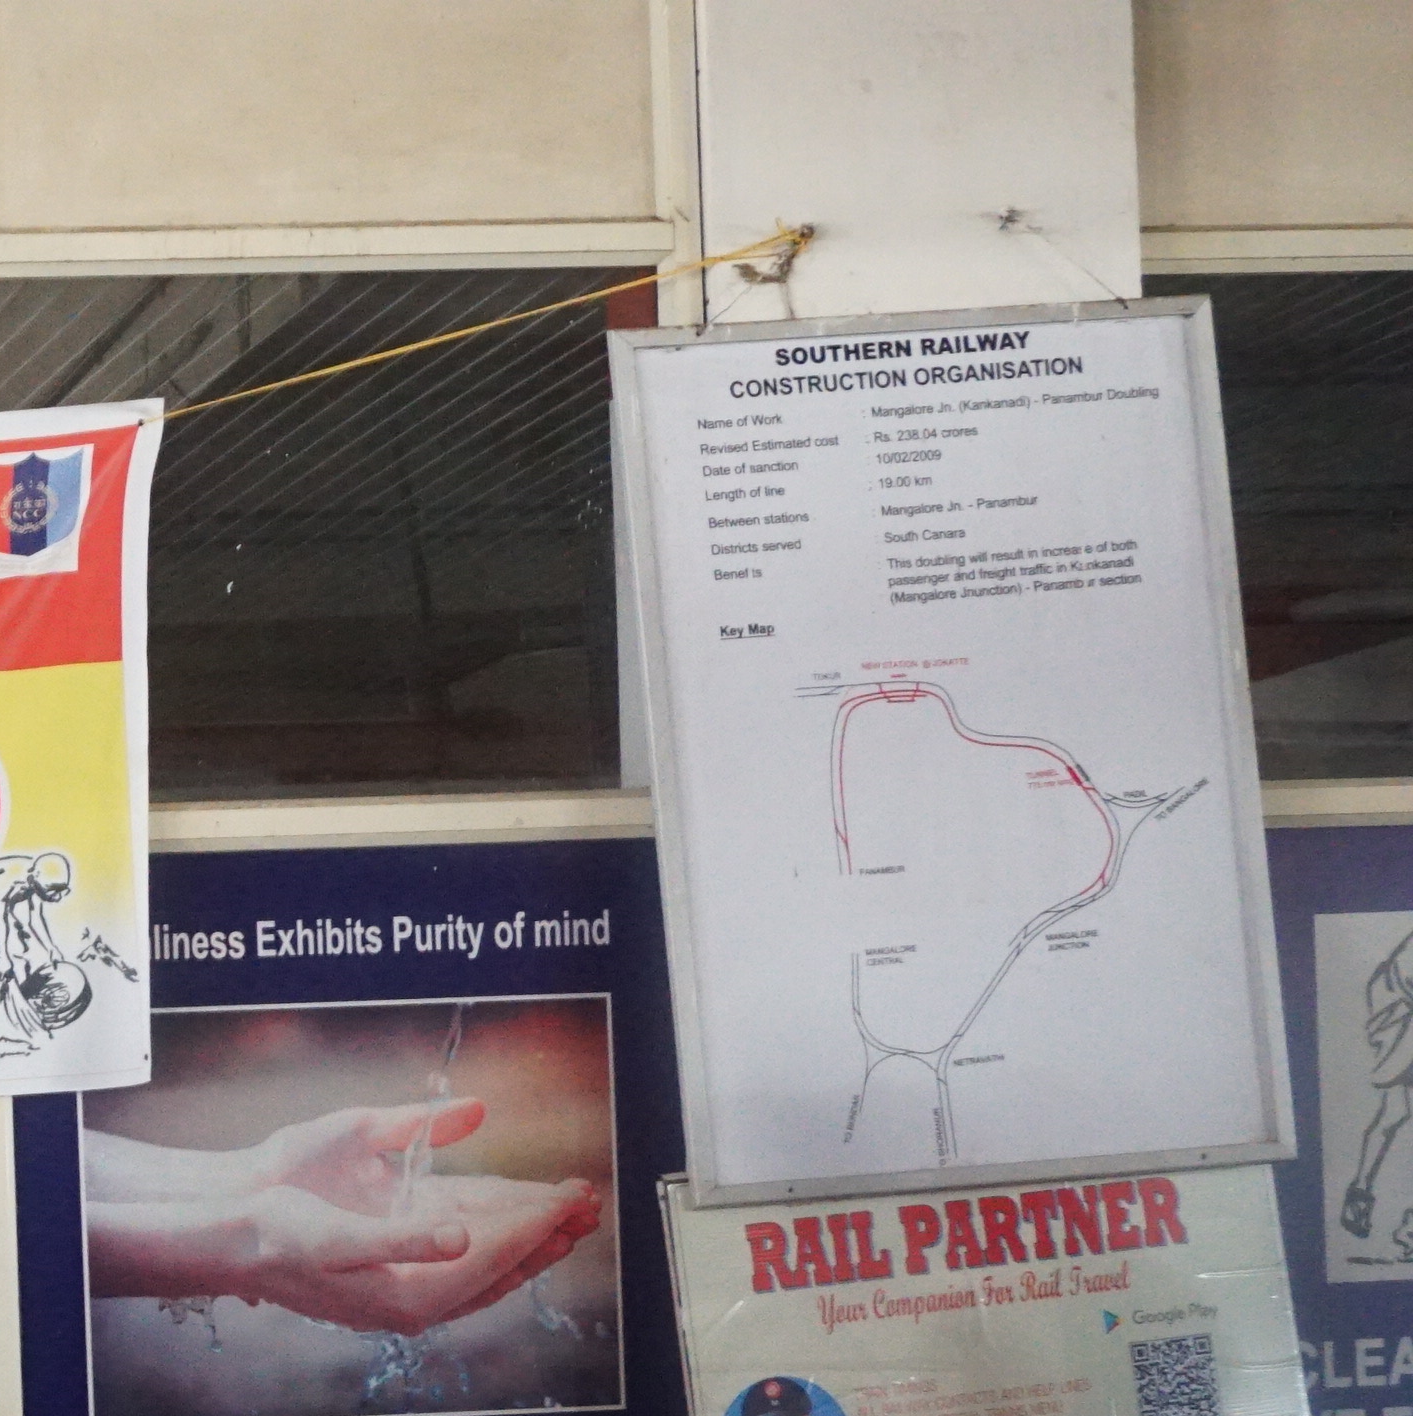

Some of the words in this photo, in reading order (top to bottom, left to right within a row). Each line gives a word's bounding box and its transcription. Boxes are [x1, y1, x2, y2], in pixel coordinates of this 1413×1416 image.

[775, 339, 911, 366] SOUTHERN
[921, 330, 1030, 355] RAILWAY
[730, 369, 907, 399] CONSTRUCTION
[914, 356, 1083, 386] ORGANISATION
[871, 404, 934, 420] Mangalore
[1107, 386, 1159, 401] Doubling
[697, 418, 733, 430] Name
[737, 415, 748, 427] of
[751, 414, 782, 426] Work
[942, 426, 978, 438] crores
[700, 441, 749, 455] Revised
[752, 437, 811, 451] Estimated
[815, 435, 839, 447] cost
[876, 450, 942, 464] 10/02/2009
[702, 465, 731, 477] Date
[735, 462, 746, 474] of
[750, 460, 798, 473] sanction
[915, 475, 932, 487] km
[705, 488, 746, 502] Length
[749, 486, 761, 498] of
[765, 485, 785, 497] line
[881, 503, 943, 518] Mangalore
[977, 495, 1038, 510] Panambur
[709, 515, 760, 528] Between
[764, 512, 810, 525] stations
[884, 531, 919, 544] South
[922, 528, 966, 541] Canara
[711, 543, 759, 556] Districts
[762, 540, 802, 552] served
[887, 557, 912, 570] This
[915, 554, 966, 568] doubling
[888, 574, 950, 589] passenger
[953, 570, 976, 582] and
[890, 588, 957, 605] (Mangalore
[720, 625, 744, 638] Key
[748, 623, 775, 637] Map
[148, 922, 246, 961] liness
[256, 918, 383, 957] Exhibits
[392, 912, 483, 959] Purity
[493, 911, 526, 949] of
[533, 909, 611, 947] mind
[745, 1209, 895, 1294] RAIL
[899, 1175, 1190, 1276] PARTNER
[818, 1293, 868, 1334] Your
[872, 1283, 976, 1325] Companion
[981, 1274, 1015, 1309] For
[1020, 1267, 1063, 1302] Rail
[1069, 1260, 1132, 1297] Travel
[1132, 1306, 1185, 1327] Google
